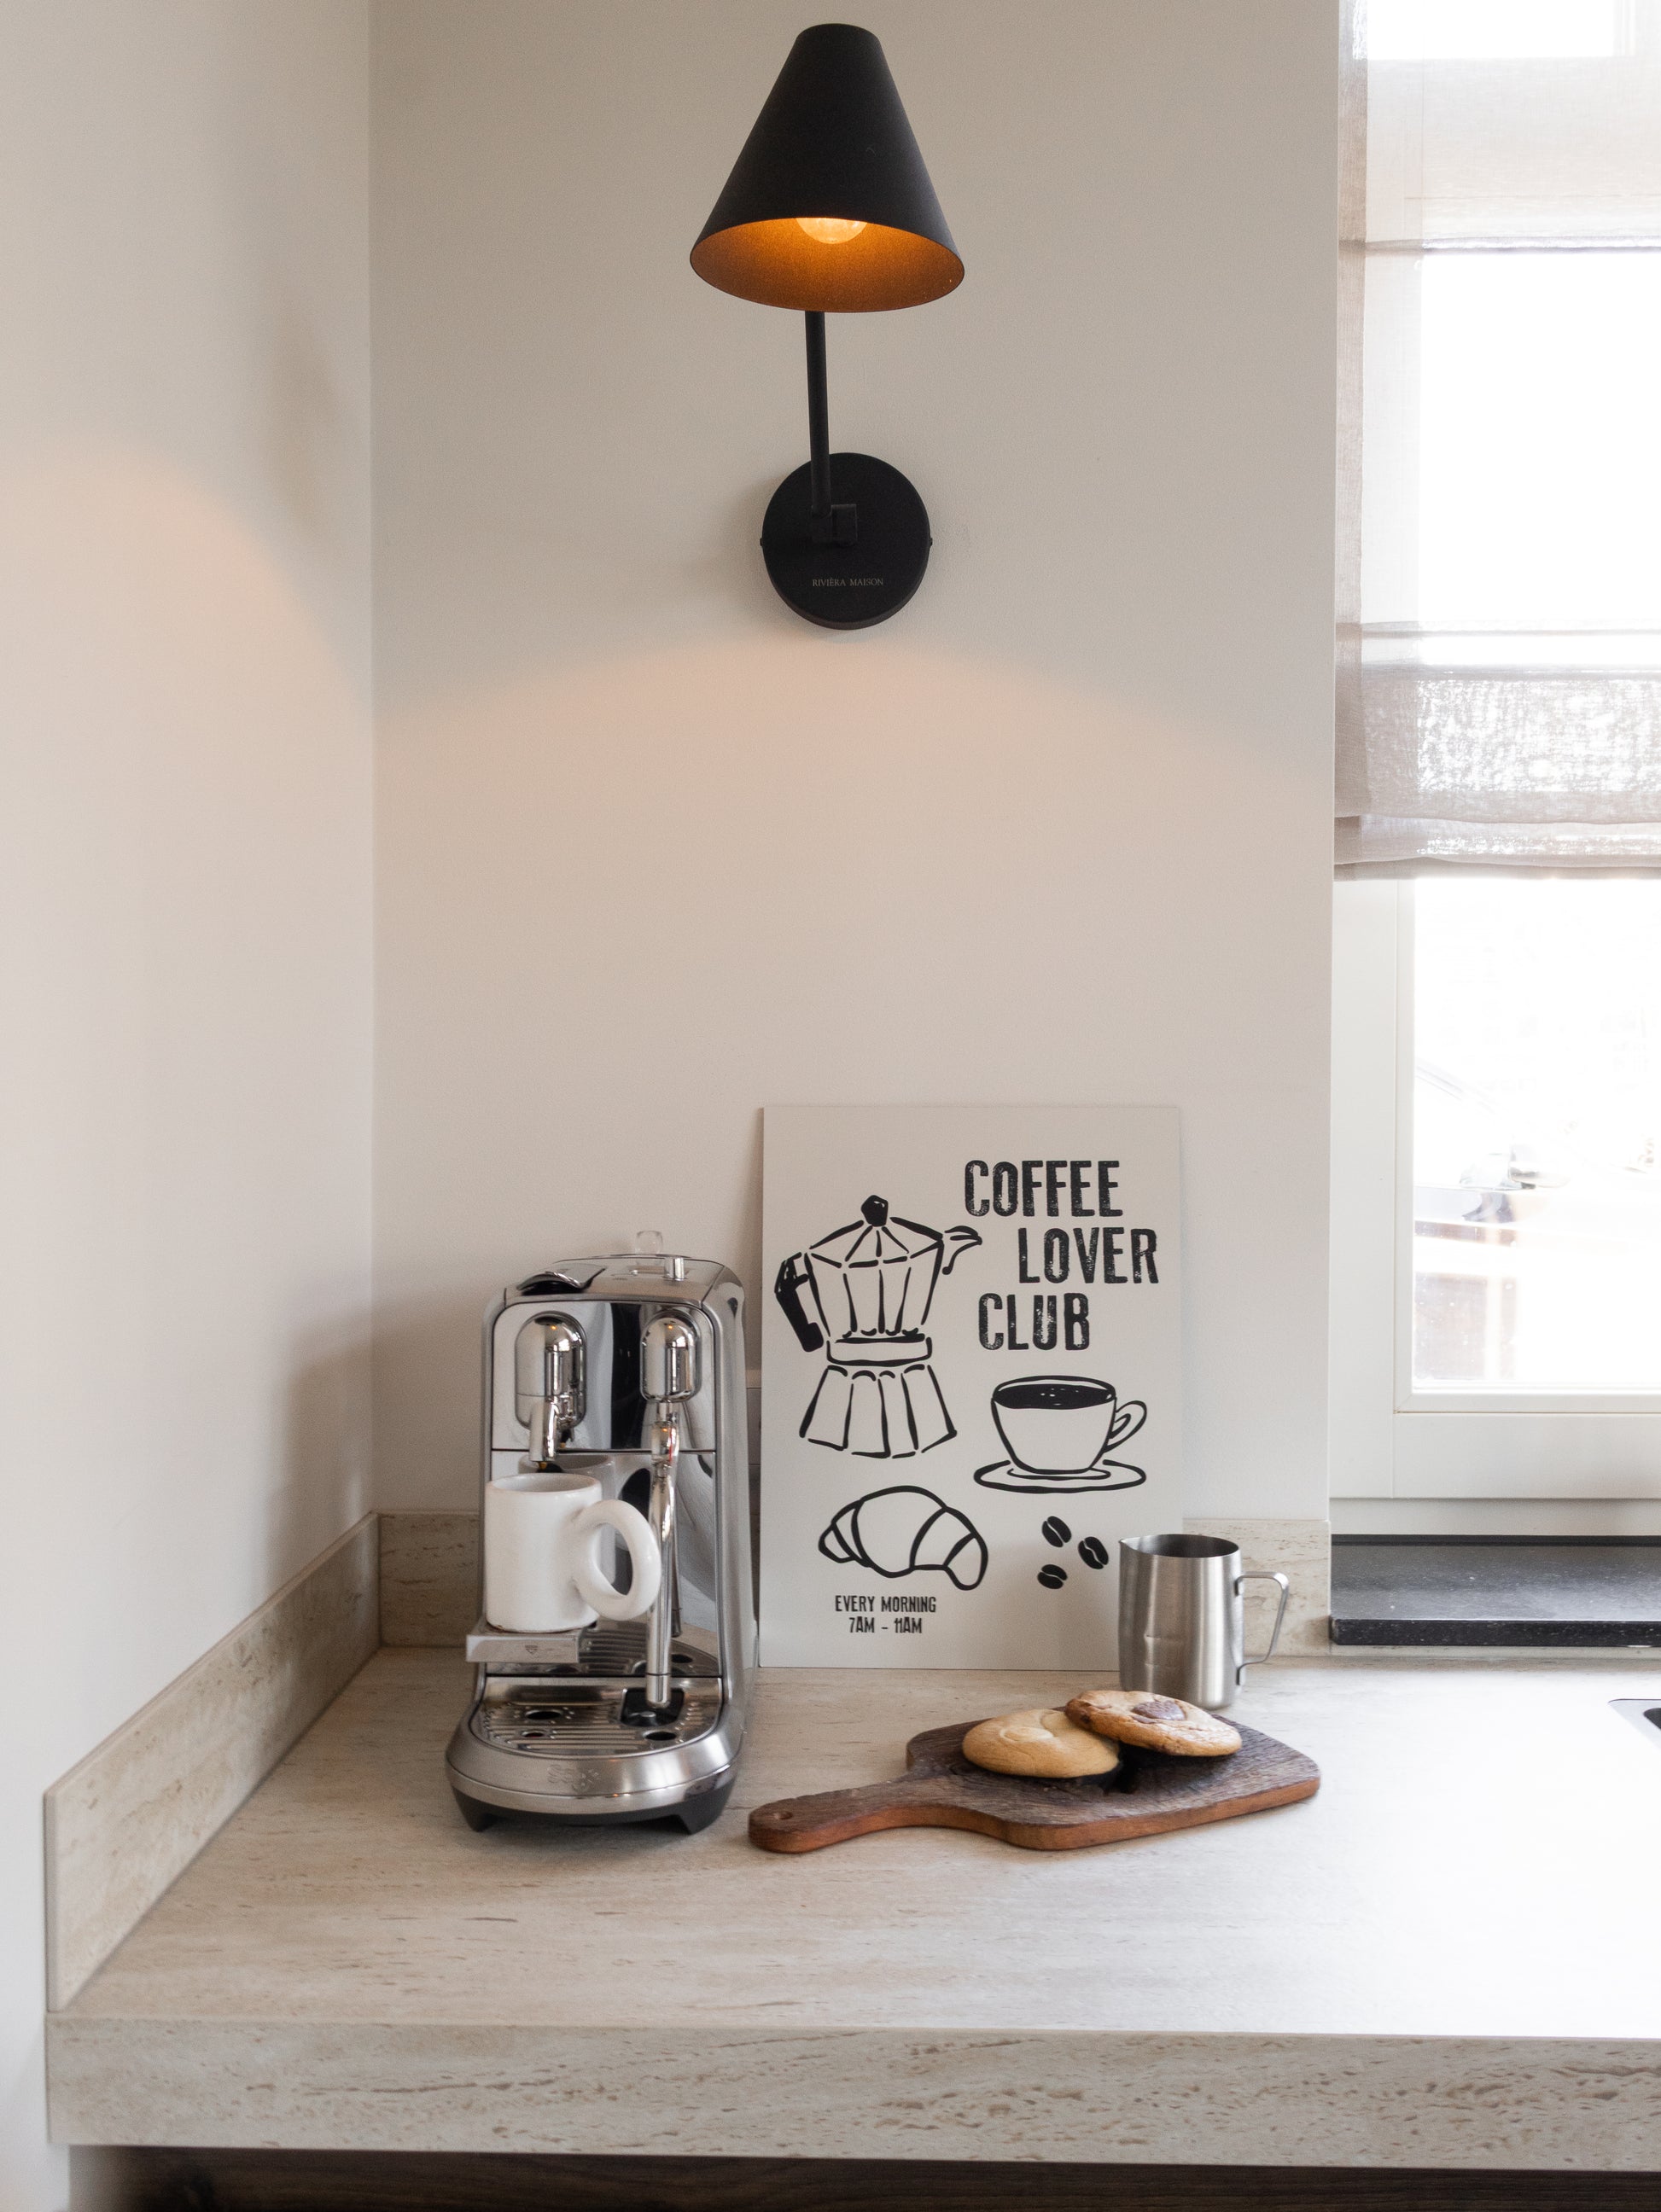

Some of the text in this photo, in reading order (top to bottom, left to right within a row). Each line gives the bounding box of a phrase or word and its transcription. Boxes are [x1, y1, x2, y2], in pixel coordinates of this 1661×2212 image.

[849, 578, 884, 586] MAISON
[965, 1161, 1123, 1218] COFFEE
[1018, 1227, 1159, 1284] LOVER
[979, 1292, 1090, 1351] CLUB
[835, 1595, 936, 1613] EVERY MORNING
[848, 1616, 875, 1633] 7AM
[894, 1616, 923, 1633] 11AM
